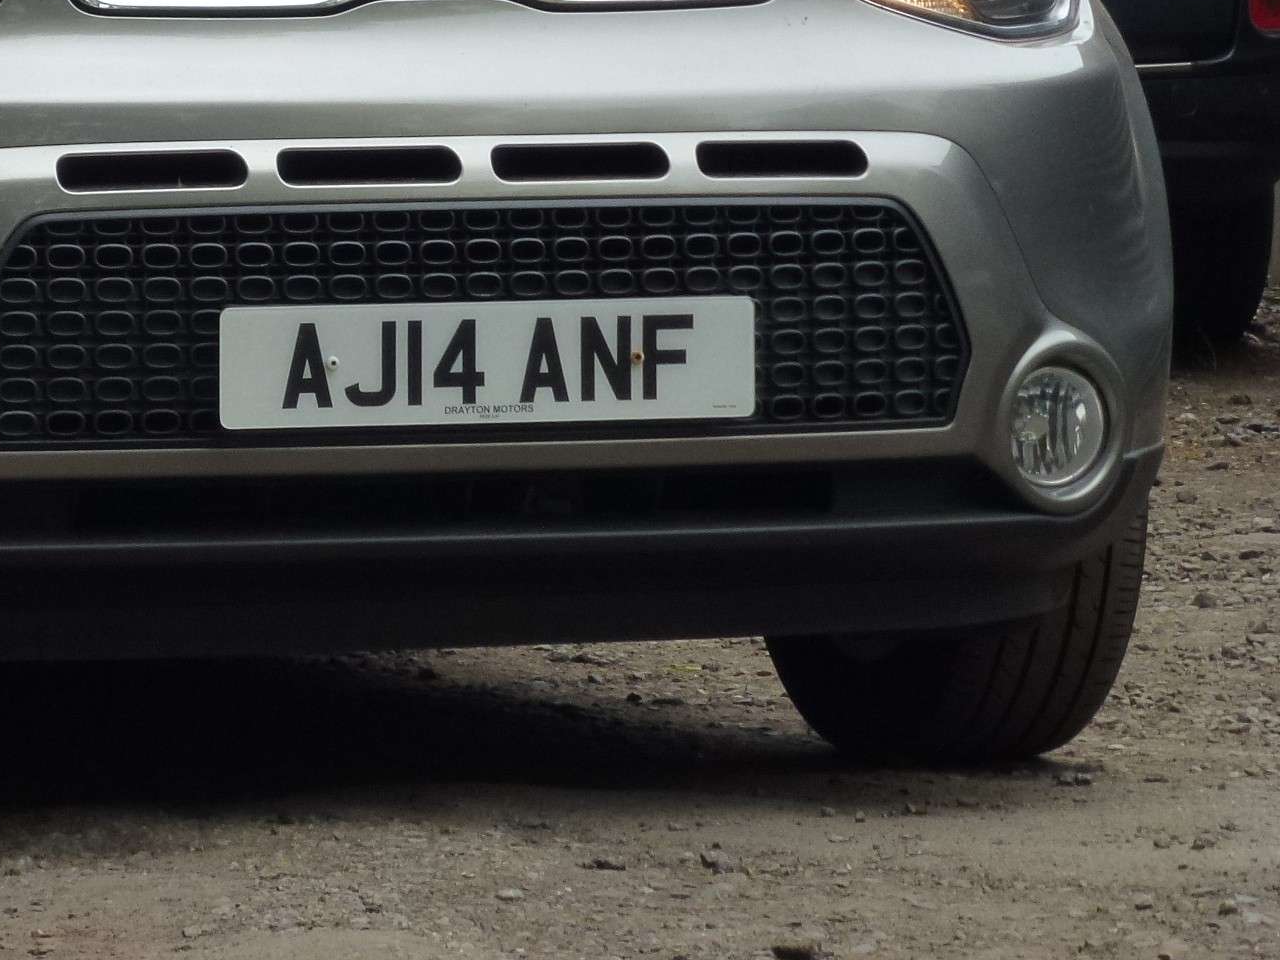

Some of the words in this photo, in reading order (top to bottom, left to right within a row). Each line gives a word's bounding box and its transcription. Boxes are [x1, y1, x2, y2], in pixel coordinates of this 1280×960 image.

[282, 318, 485, 409] AJ14
[519, 313, 694, 404] ANF
[444, 405, 490, 415] DRAYTON
[493, 404, 534, 414] MOTORS
